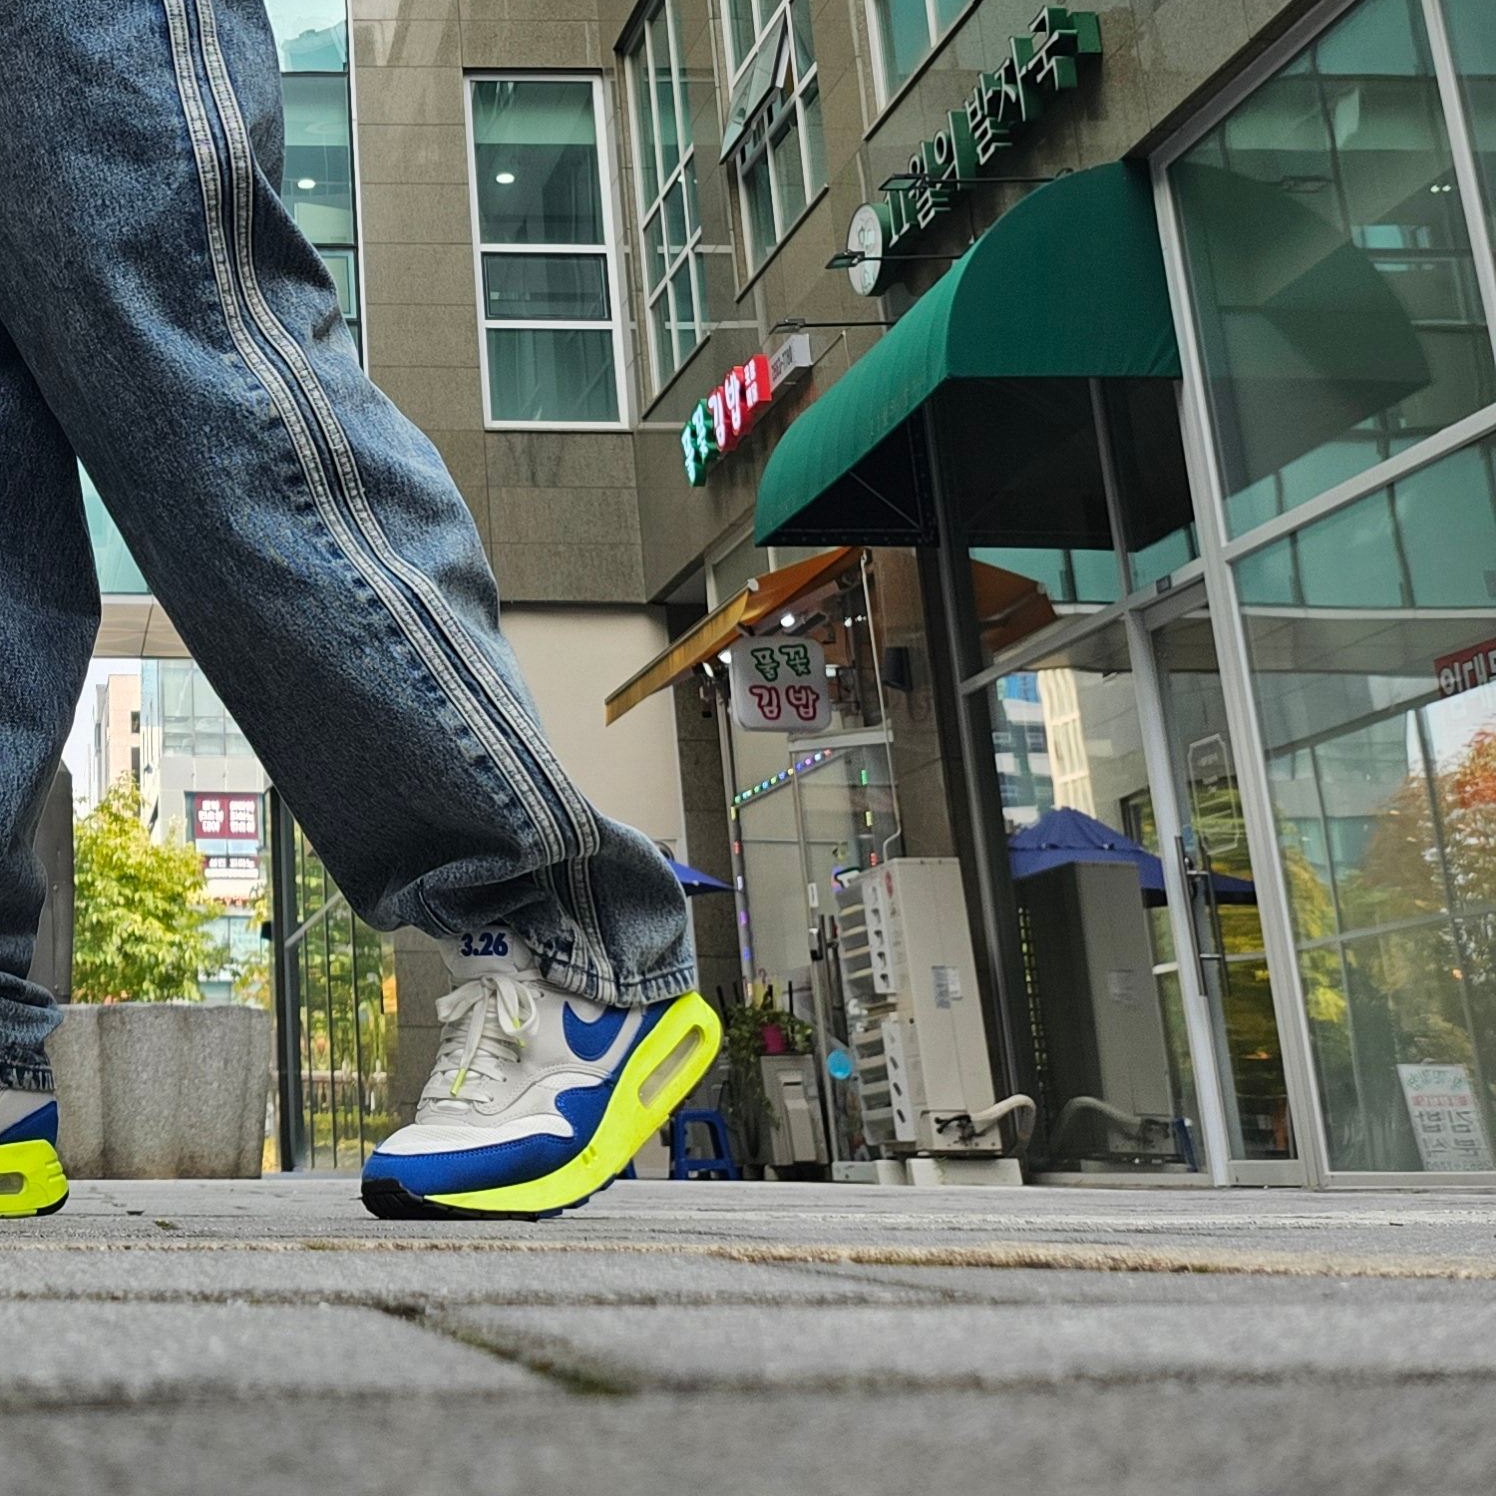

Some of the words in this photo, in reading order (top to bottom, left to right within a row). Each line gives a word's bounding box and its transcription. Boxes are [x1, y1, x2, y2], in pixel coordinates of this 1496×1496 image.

[965, 5, 1061, 166] 발자국
[750, 644, 812, 682] 풀꽃
[749, 684, 820, 721] 김밥
[460, 932, 509, 957] 3.26
